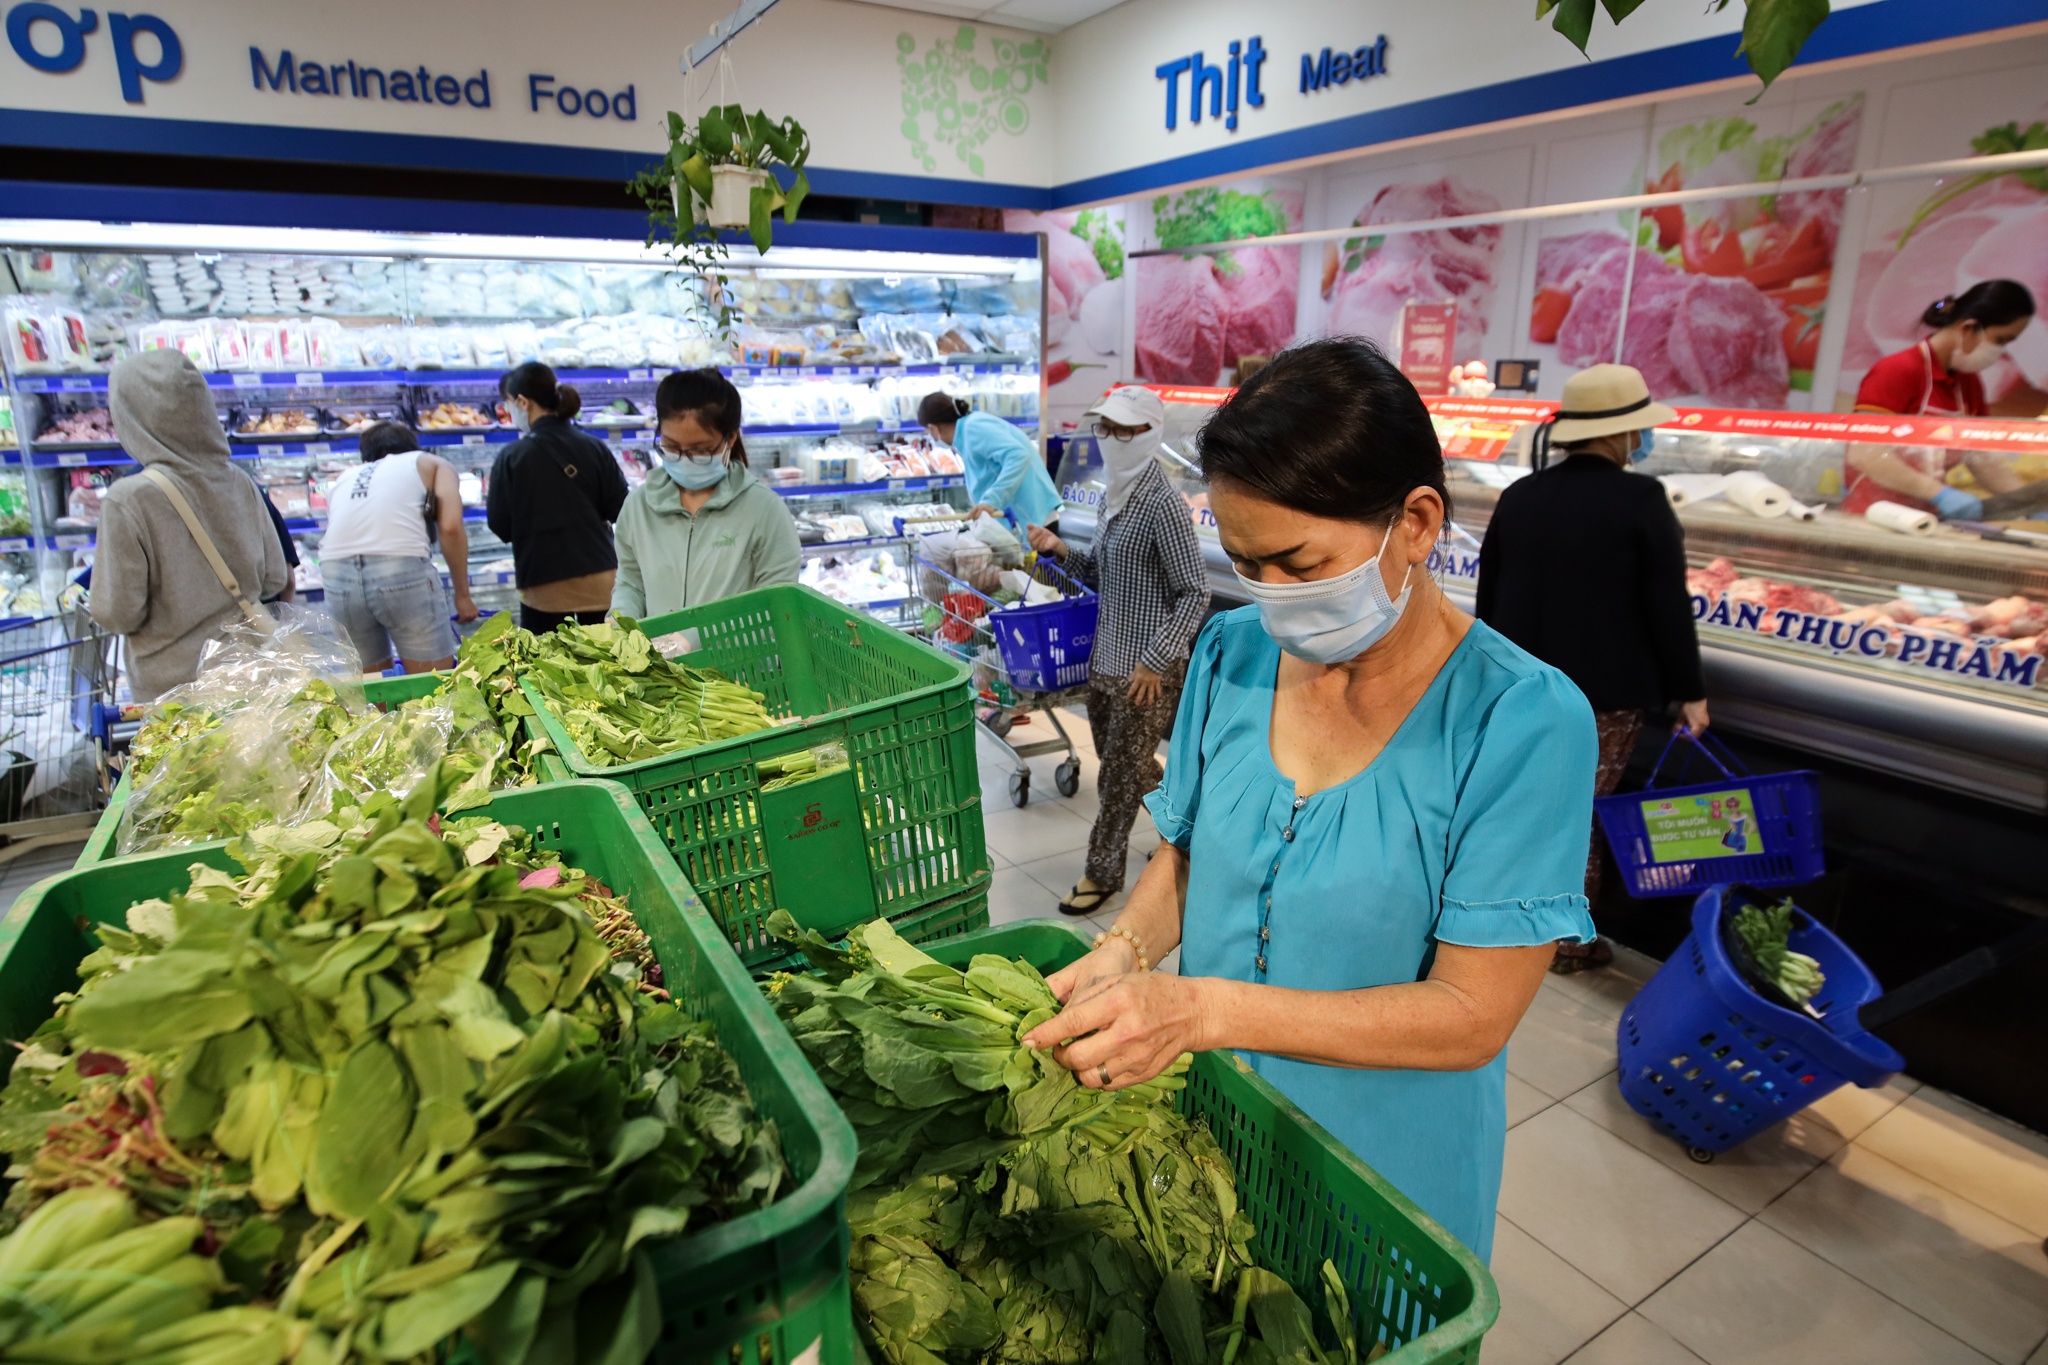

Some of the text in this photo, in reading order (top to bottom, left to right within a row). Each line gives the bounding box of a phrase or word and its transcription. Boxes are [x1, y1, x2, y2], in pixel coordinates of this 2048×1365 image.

[249, 46, 638, 121] Marinated Food
[1155, 34, 1388, 130] Thịt Meat
[1691, 592, 1766, 631] OÀN
[1776, 608, 1888, 656] THỰC
[1898, 633, 2041, 686] PHẨM
